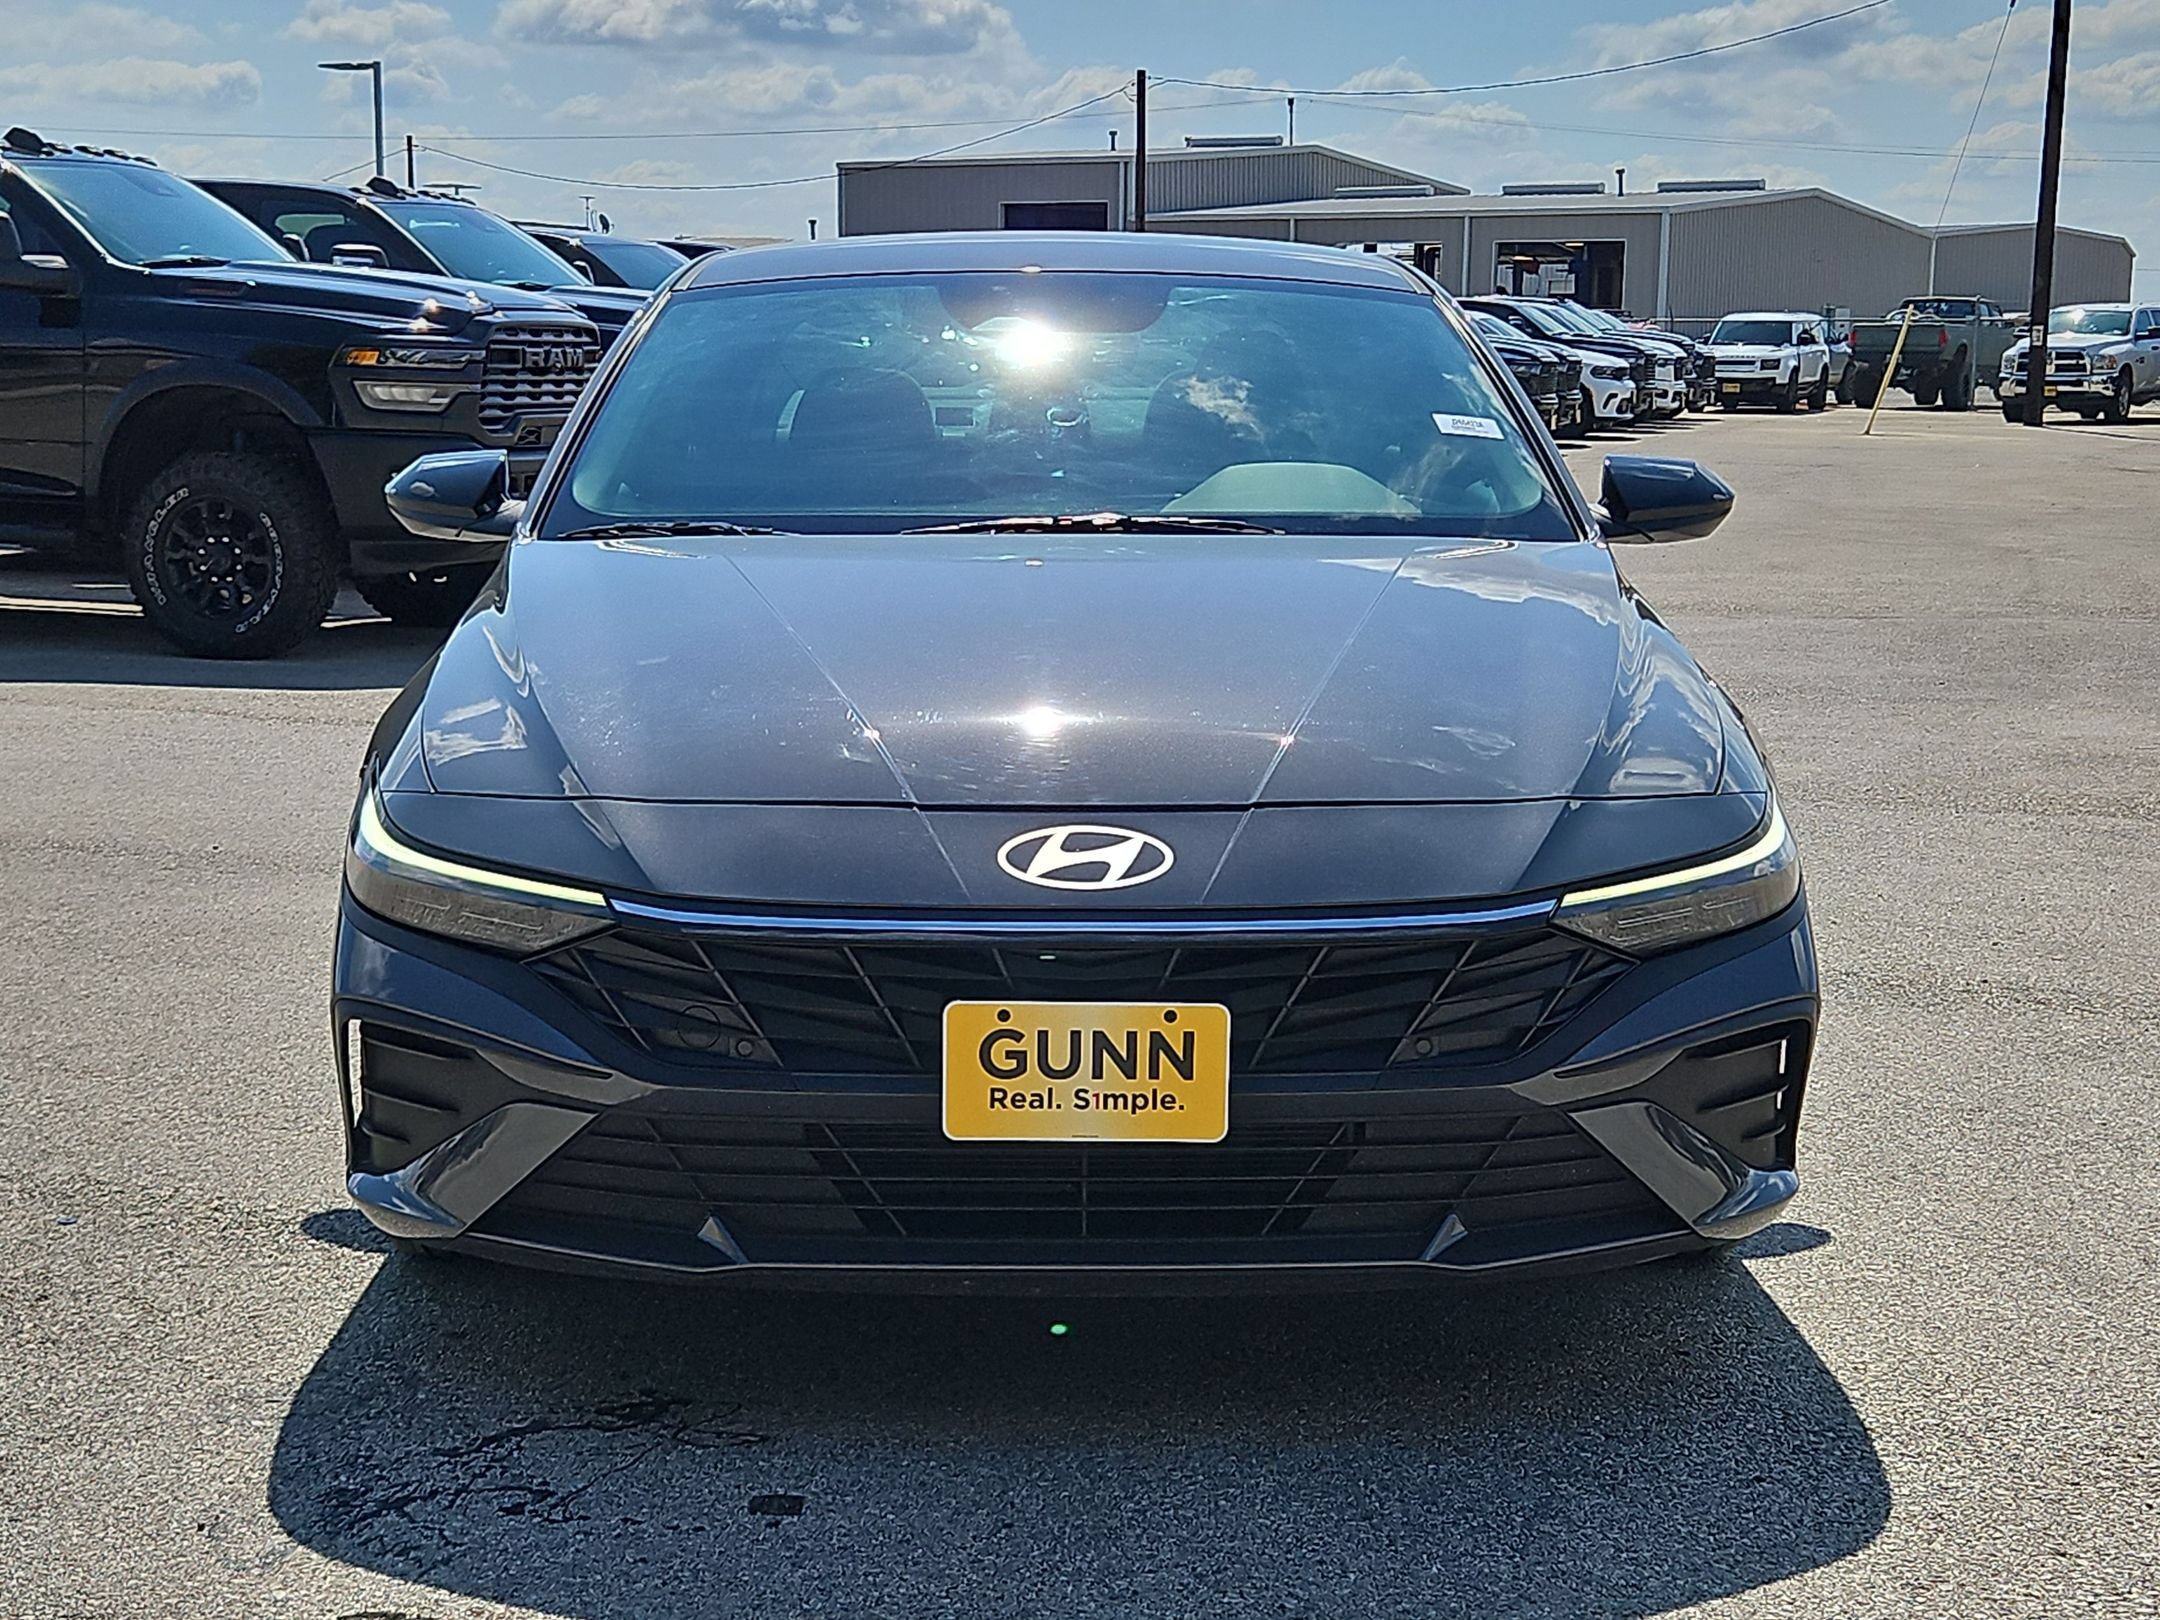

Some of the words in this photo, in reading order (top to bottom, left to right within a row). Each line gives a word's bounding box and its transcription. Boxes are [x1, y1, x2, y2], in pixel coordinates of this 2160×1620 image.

[525, 347, 583, 368] RAM
[144, 487, 190, 605] WRANGLER
[235, 512, 283, 632] GOODYEAR
[978, 1028, 1195, 1081] GUNN
[989, 1087, 1062, 1110] Real.
